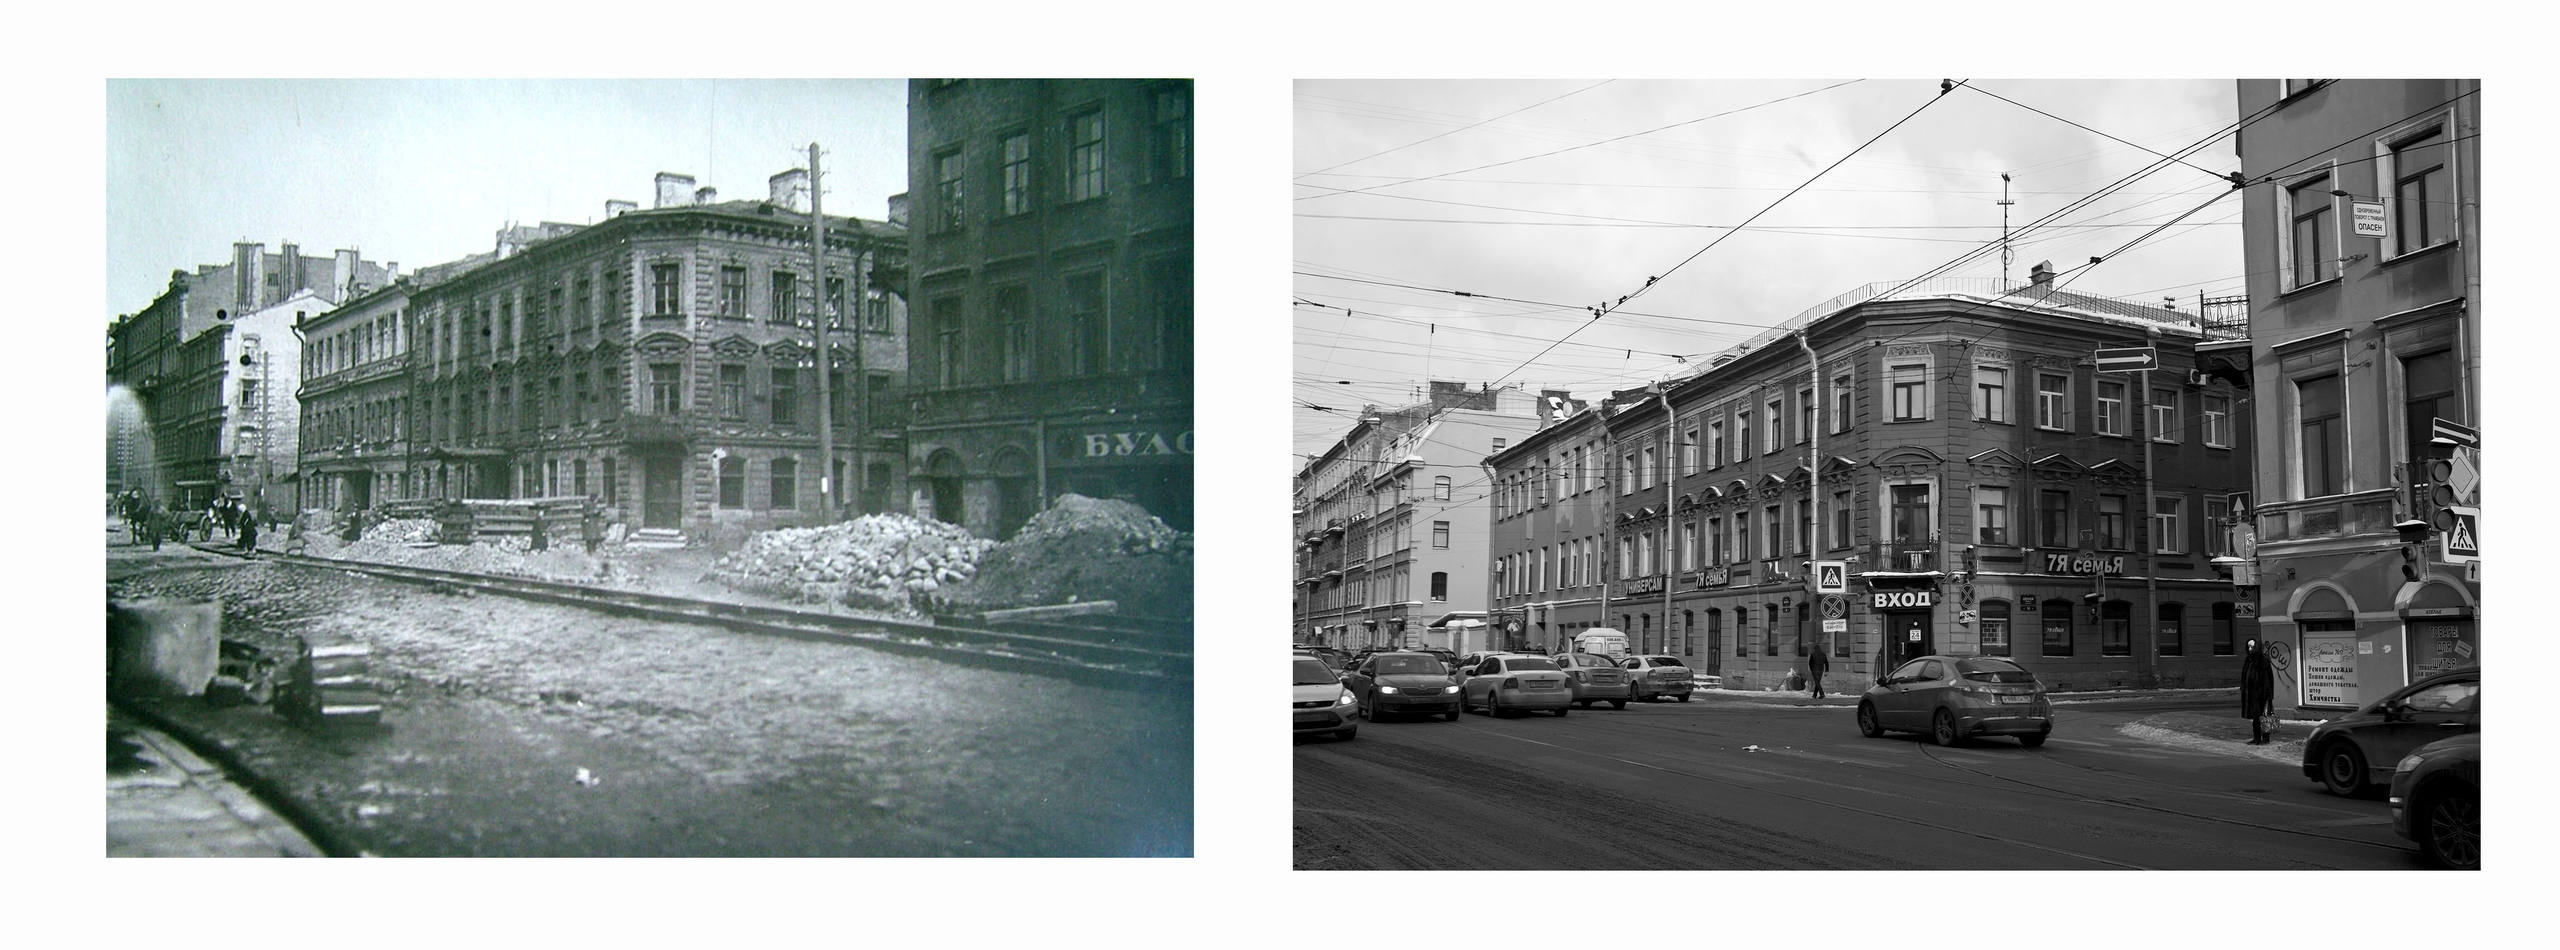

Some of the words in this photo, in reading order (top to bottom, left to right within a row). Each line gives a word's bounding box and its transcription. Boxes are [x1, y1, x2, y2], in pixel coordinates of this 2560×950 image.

[2358, 223, 2382, 231] ОПАСЕН
[2047, 553, 2069, 572] 7Я
[2072, 556, 2124, 574] семьЯ
[1695, 572, 1705, 588] 7Я
[1705, 568, 1728, 586] семьЯ
[1624, 577, 1663, 595] УНИВЕРСАМ
[1874, 591, 1931, 608] ВХОД
[2429, 625, 2459, 638] ТОВАРЫ
[2437, 641, 2452, 654] ДЛЯ
[2308, 665, 2329, 673] Ремонт
[2432, 658, 2457, 670] ШИТЬЯ
[2309, 693, 2341, 703] Химчистка
